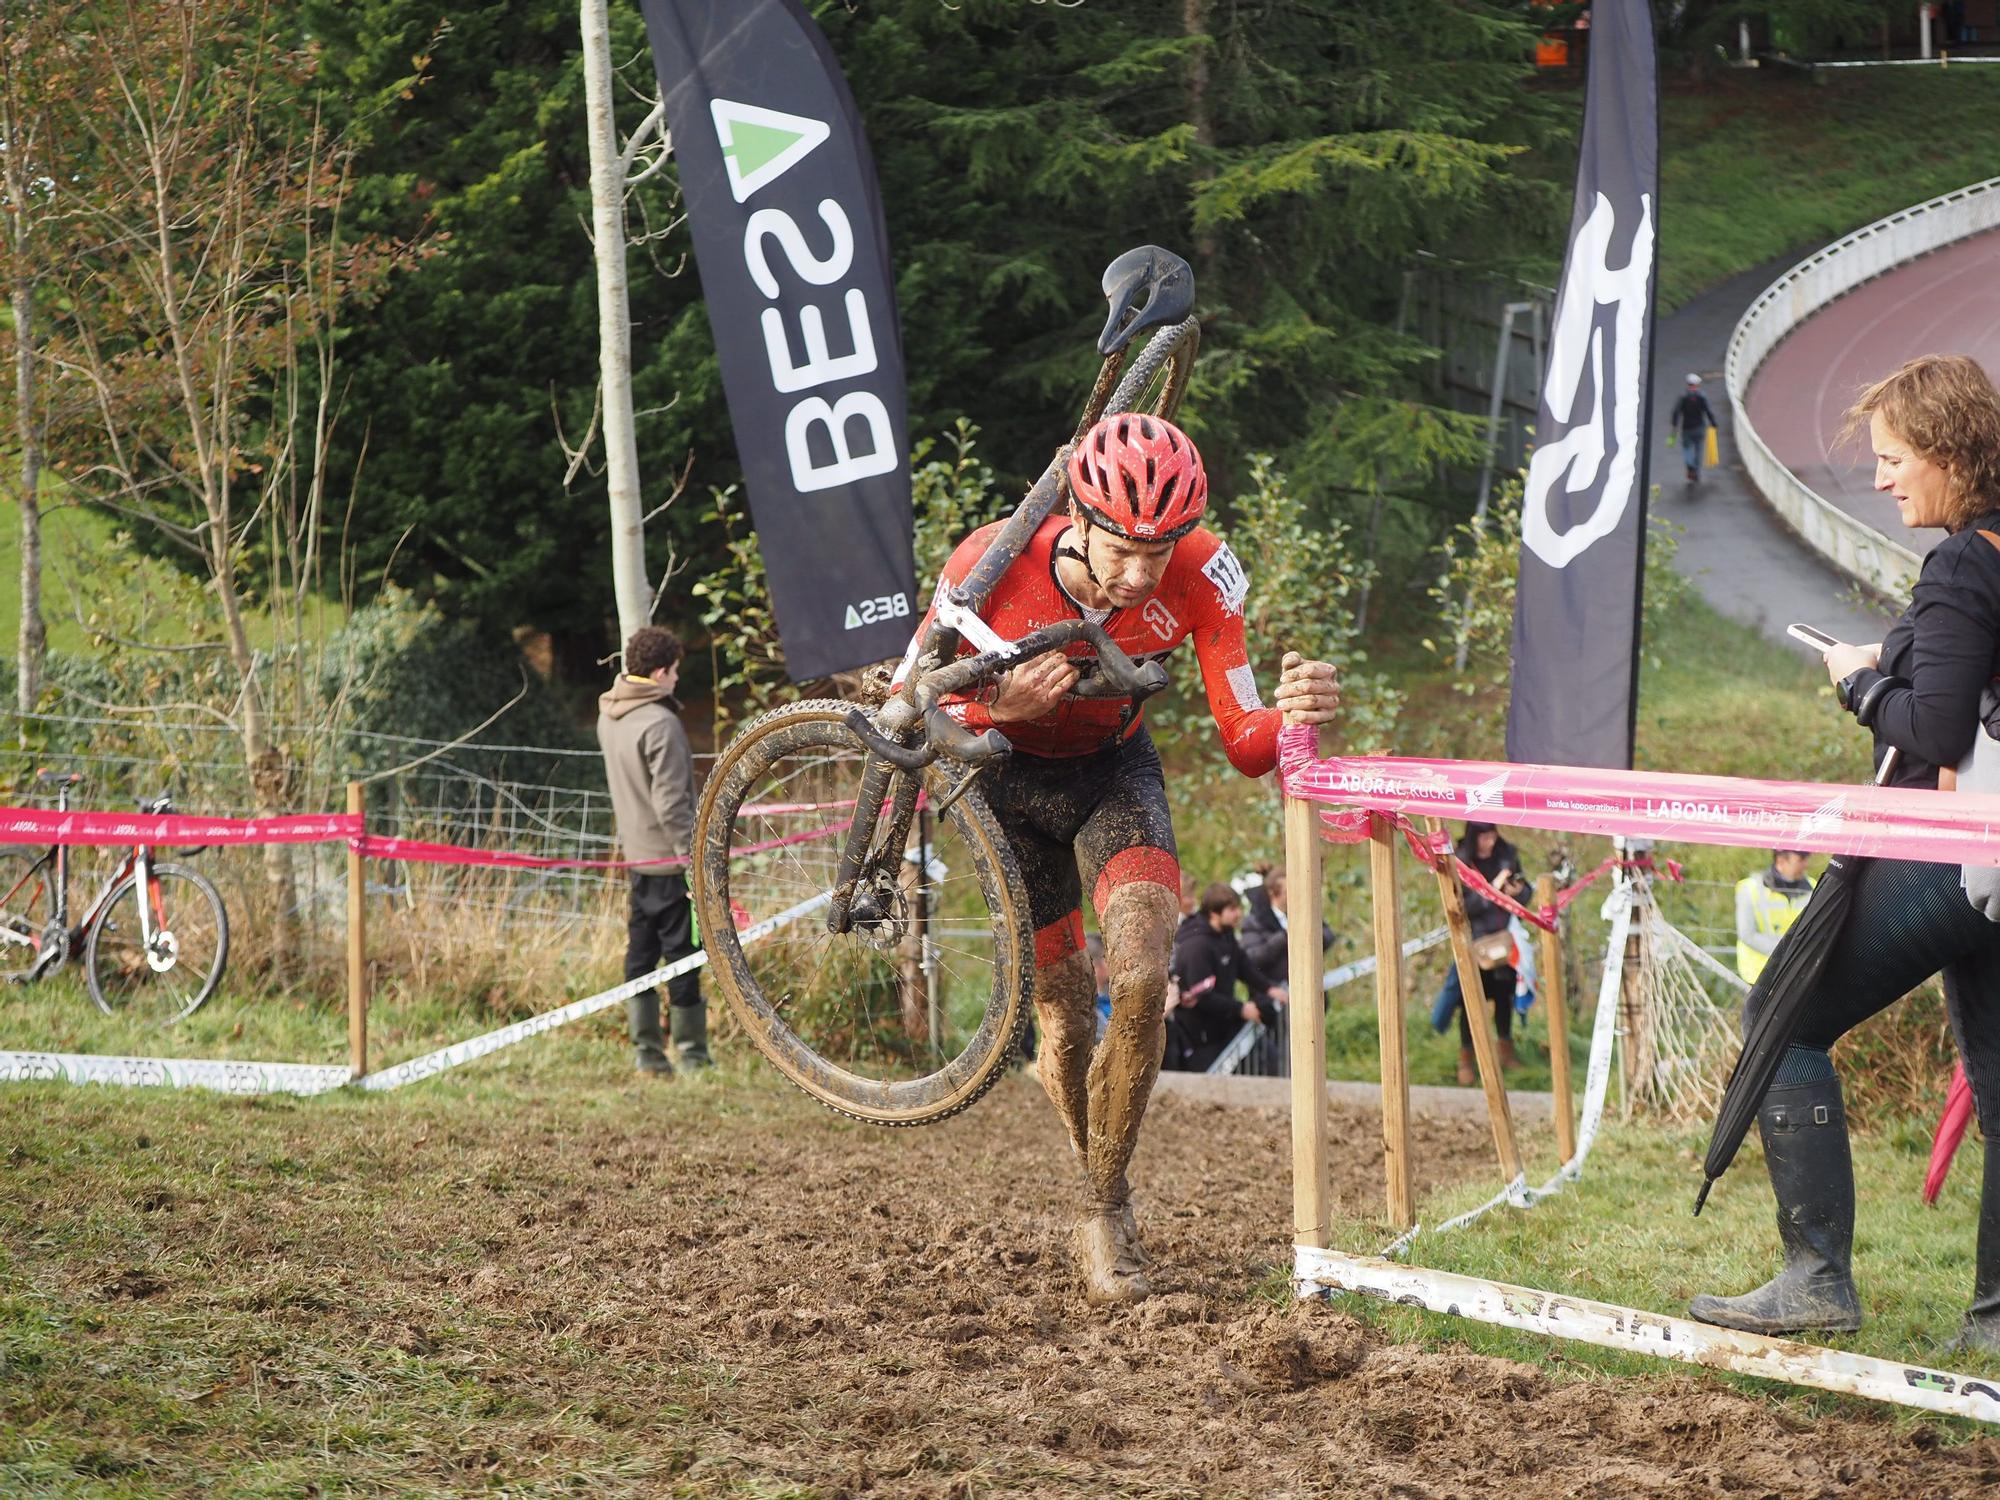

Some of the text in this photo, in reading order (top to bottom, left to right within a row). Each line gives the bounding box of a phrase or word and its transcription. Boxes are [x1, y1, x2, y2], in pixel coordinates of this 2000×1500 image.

[1328, 772, 1405, 796] LABORAL
[1546, 799, 1569, 808] banka
[1646, 799, 1731, 823] LABORAL
